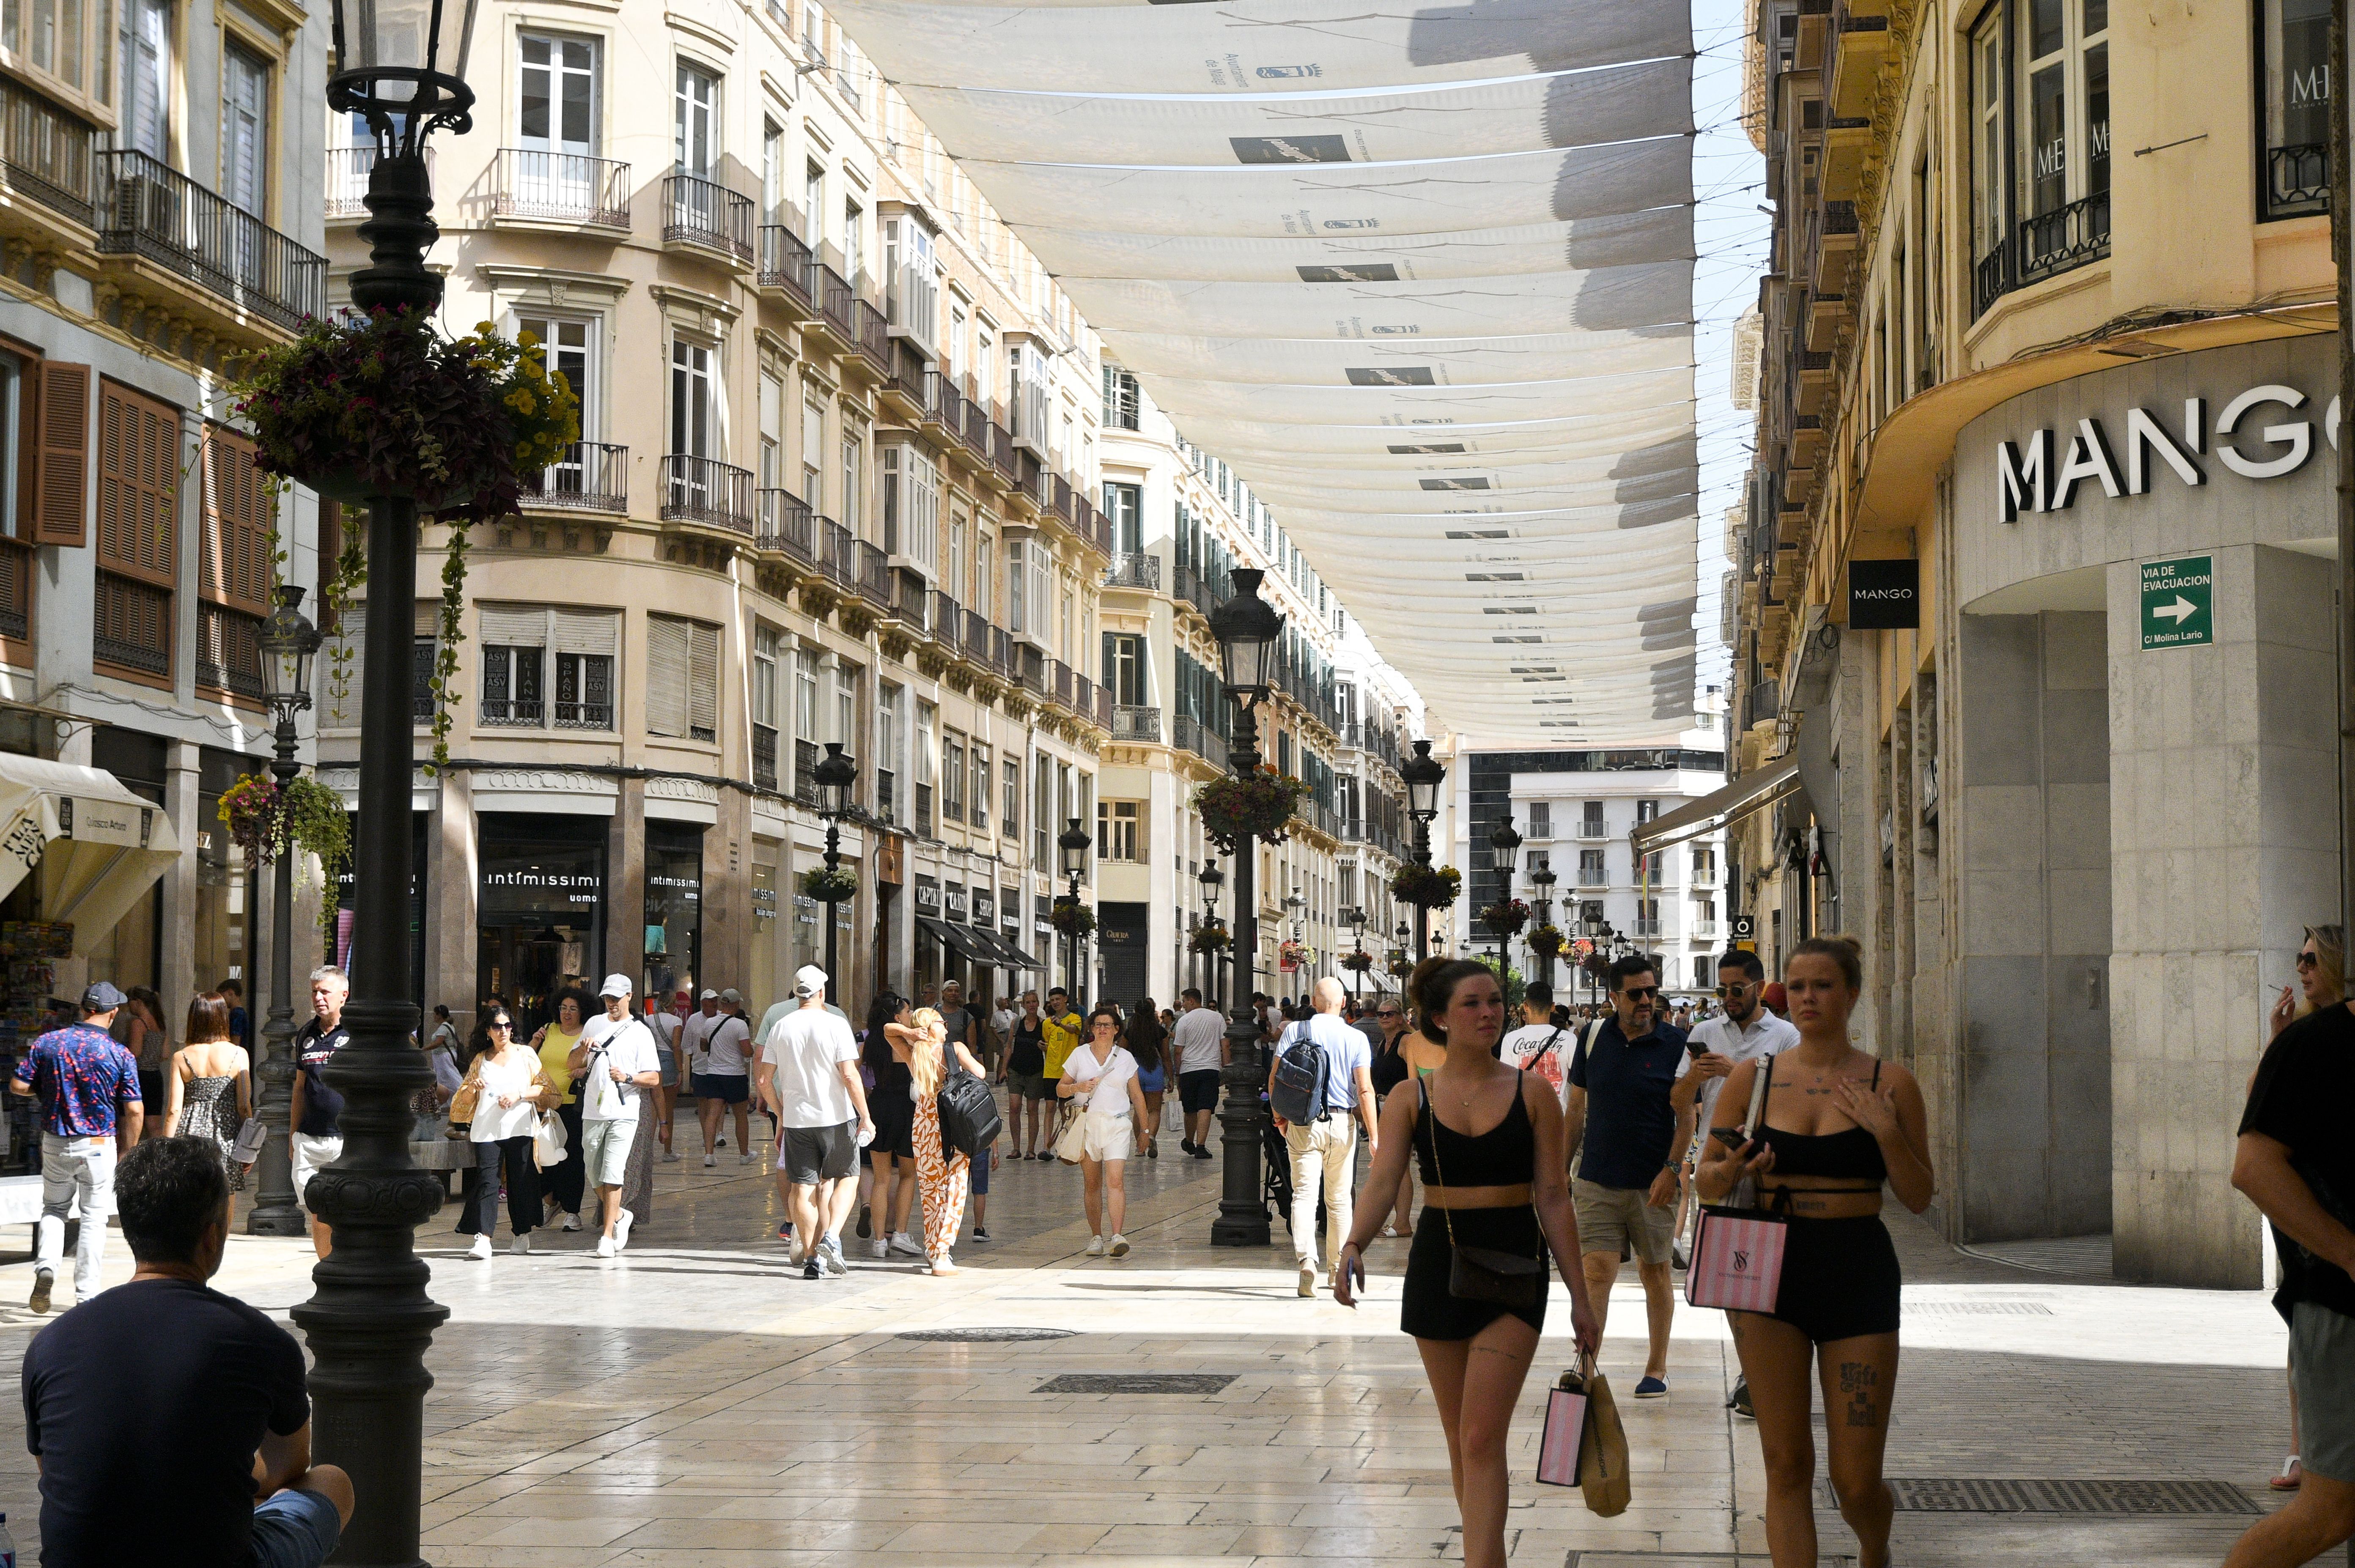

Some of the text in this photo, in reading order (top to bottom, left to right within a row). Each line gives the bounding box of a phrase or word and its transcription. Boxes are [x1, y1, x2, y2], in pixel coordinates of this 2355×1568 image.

[1998, 384, 2341, 524] MANG
[2143, 566, 2175, 578] VIA DE
[2144, 575, 2210, 592] EVACUACION
[1855, 589, 1912, 600] MANGO
[2144, 630, 2202, 644] C/ Molina Lario
[489, 872, 599, 887] intimissimi
[651, 875, 699, 888] intimissimi
[979, 899, 993, 918] SHOP
[1057, 1032, 1062, 1041] 10
